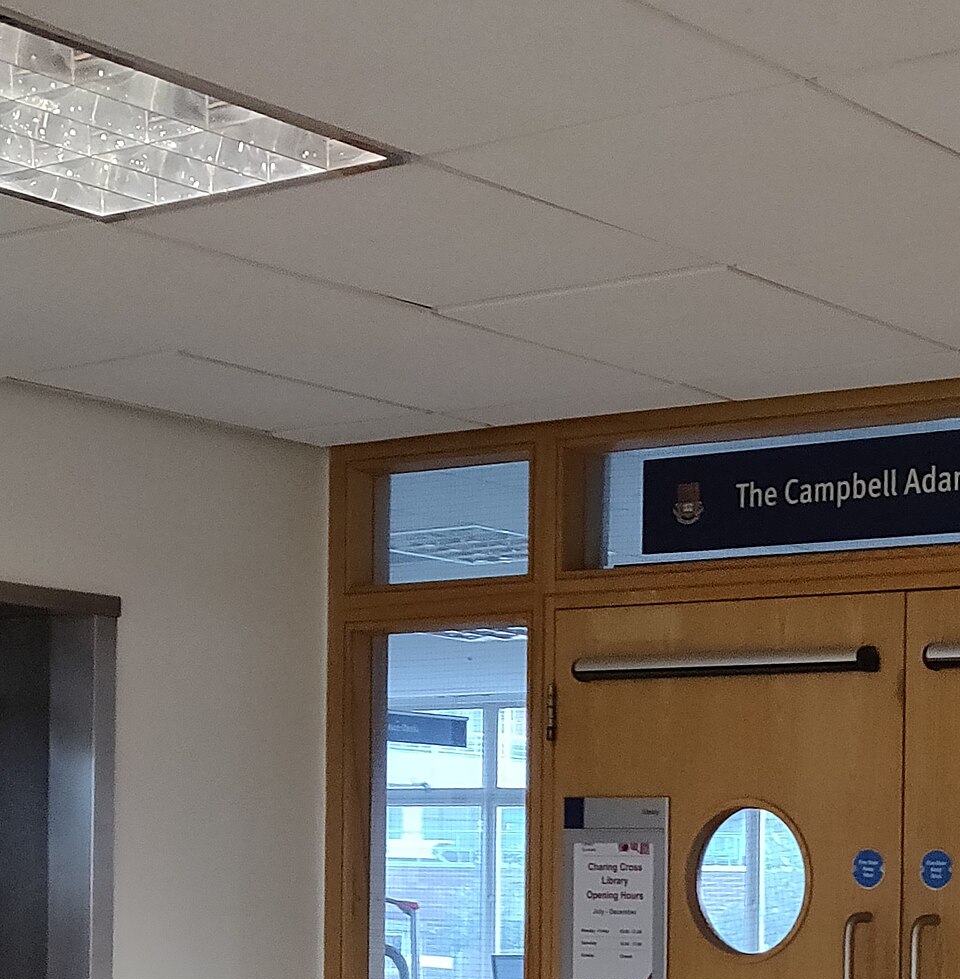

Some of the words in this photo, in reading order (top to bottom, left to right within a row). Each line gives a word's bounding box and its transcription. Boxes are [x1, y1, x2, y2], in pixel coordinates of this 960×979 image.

[736, 482, 778, 509] The
[784, 469, 898, 508] Campbell
[587, 863, 618, 872] Charing
[619, 863, 643, 871] Cross
[601, 876, 629, 887] Library
[586, 890, 618, 901] Opening
[620, 891, 644, 900] Hours
